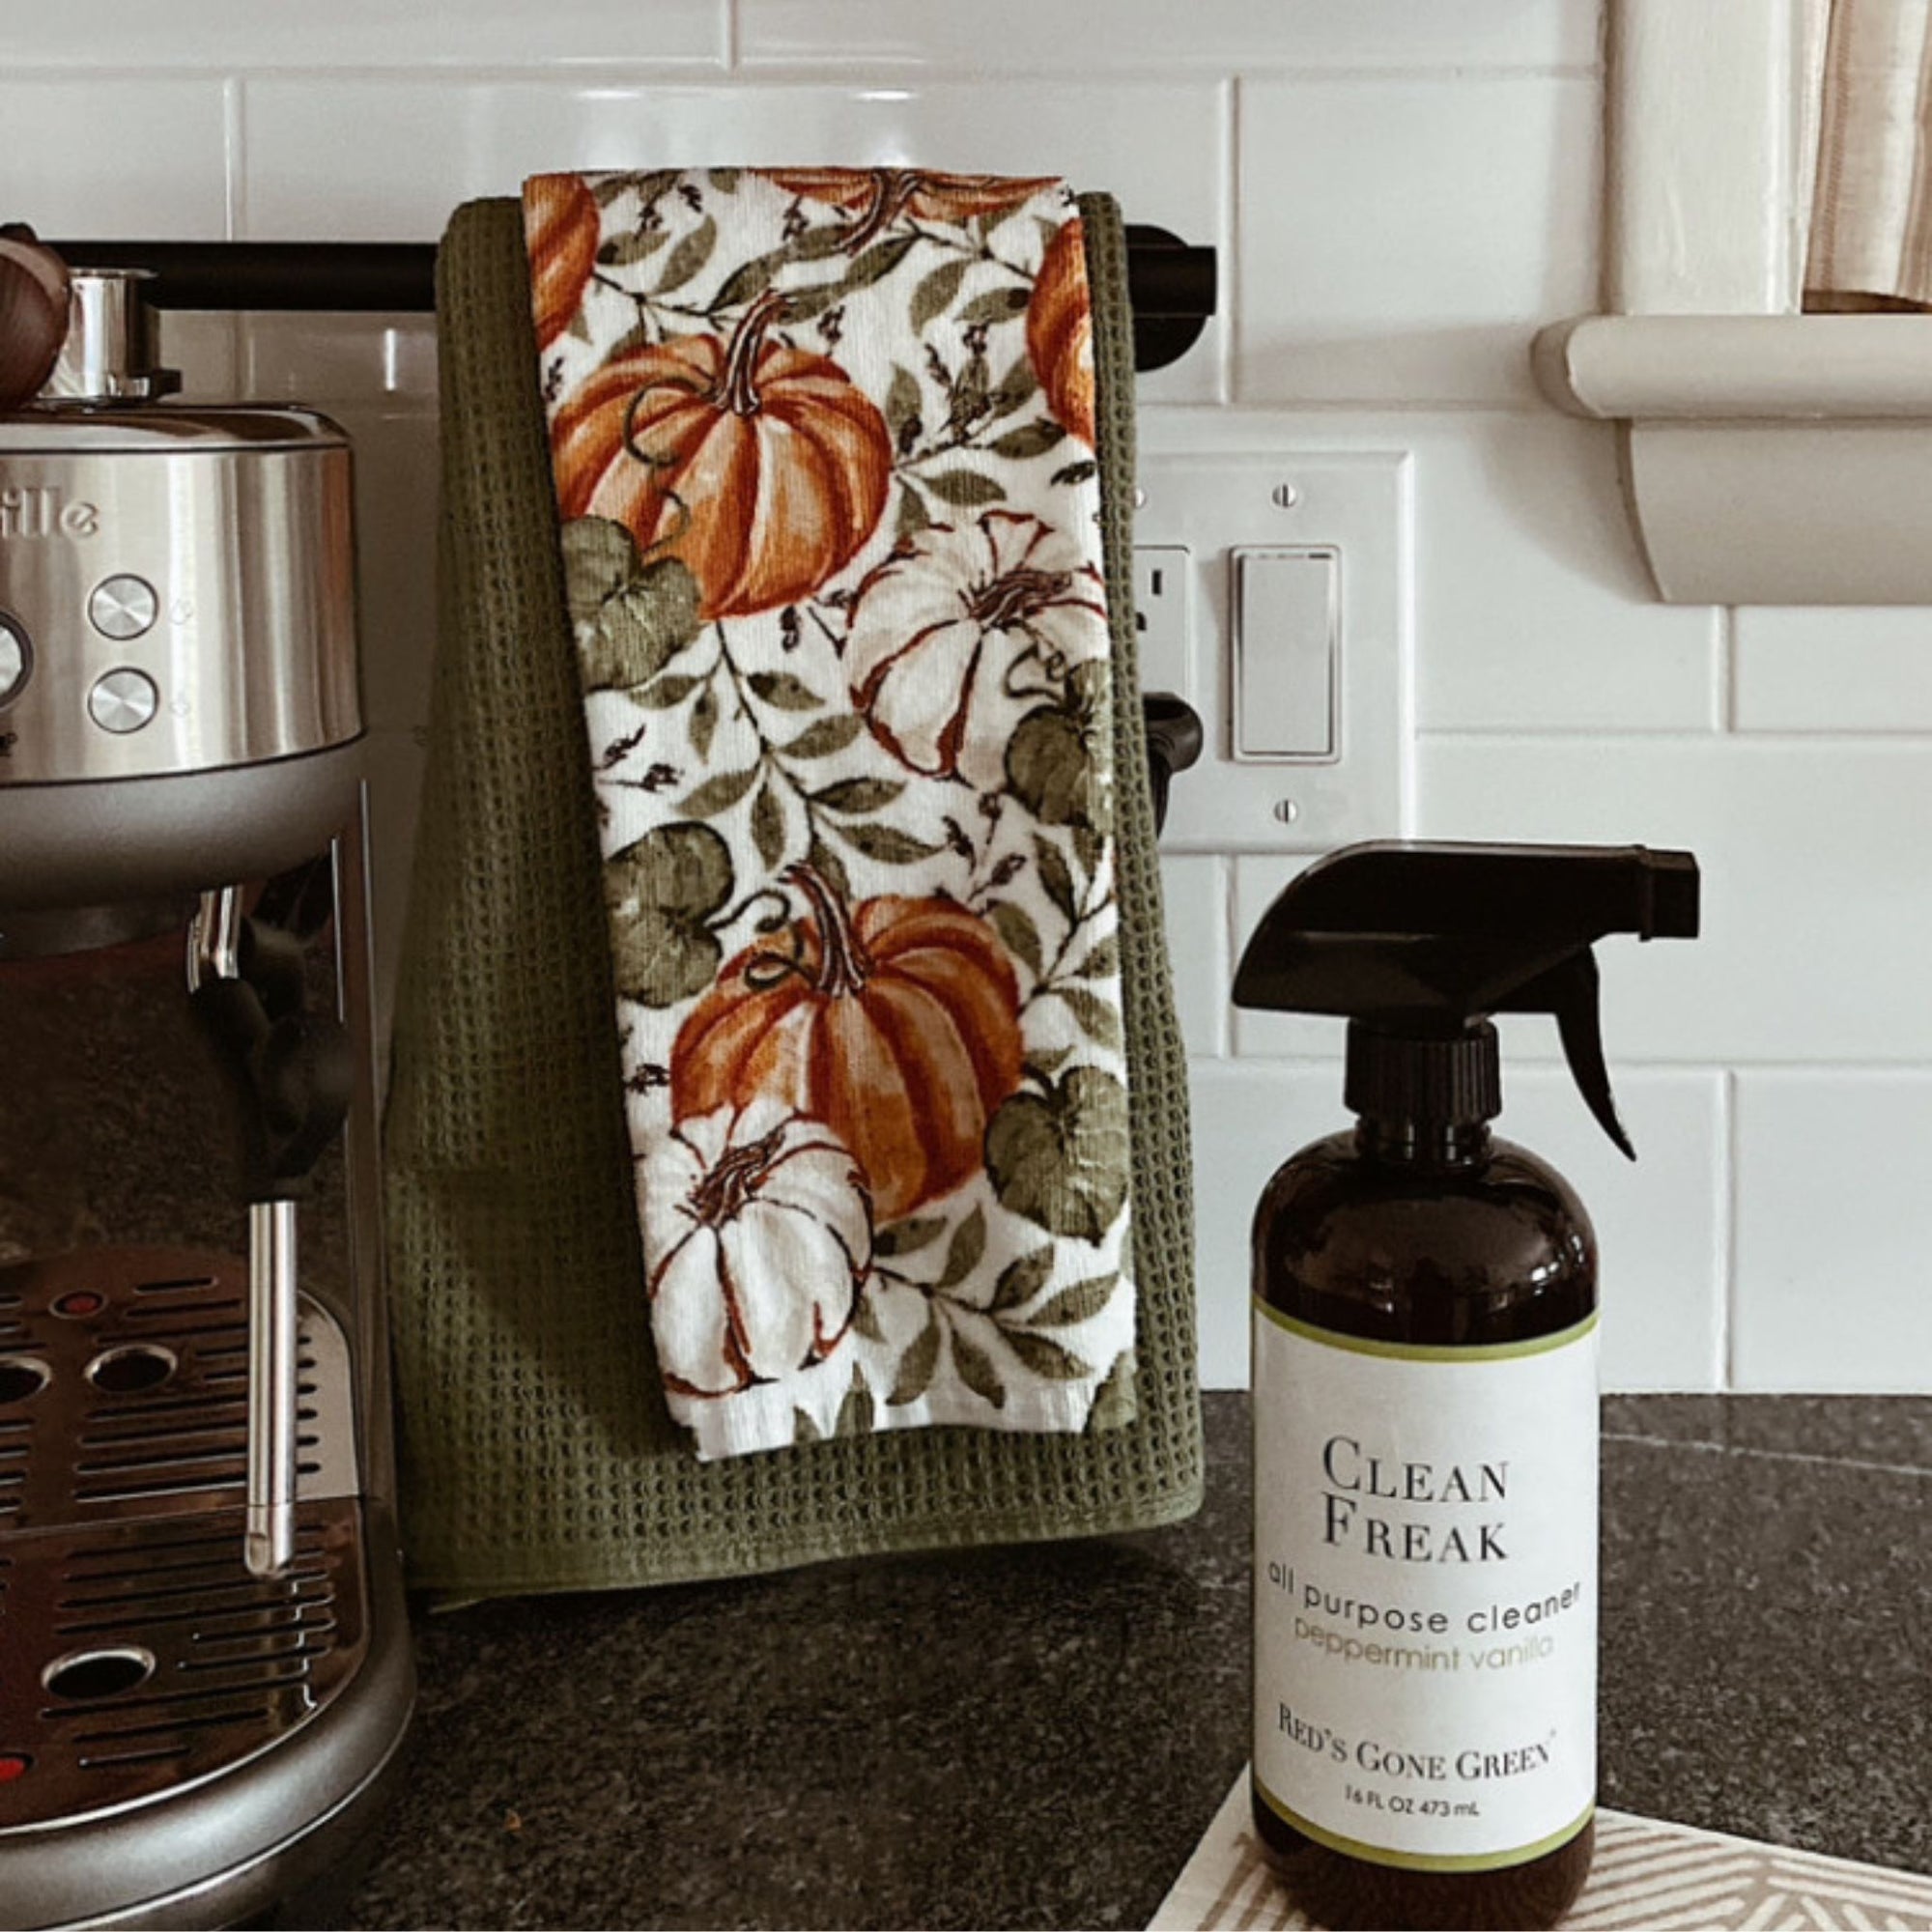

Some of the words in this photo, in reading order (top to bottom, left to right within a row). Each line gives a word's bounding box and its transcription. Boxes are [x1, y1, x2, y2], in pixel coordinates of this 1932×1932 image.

[1322, 1435, 1509, 1503] CLEAN
[1321, 1492, 1507, 1563] FREAK
[1267, 1561, 1294, 1594] all
[1304, 1584, 1449, 1634] purpose
[1466, 1581, 1580, 1634] cleaner
[1294, 1616, 1461, 1671] peppermint
[1469, 1635, 1554, 1670] vanilla
[1279, 1701, 1349, 1764] RED'S
[1356, 1741, 1446, 1781] GONE
[1455, 1741, 1550, 1781] GREEN
[1345, 1784, 1364, 1805] 16
[1367, 1789, 1384, 1810] FL
[1388, 1795, 1414, 1815] OZ
[1418, 1800, 1450, 1818] 473
[1453, 1800, 1481, 1817] mL
